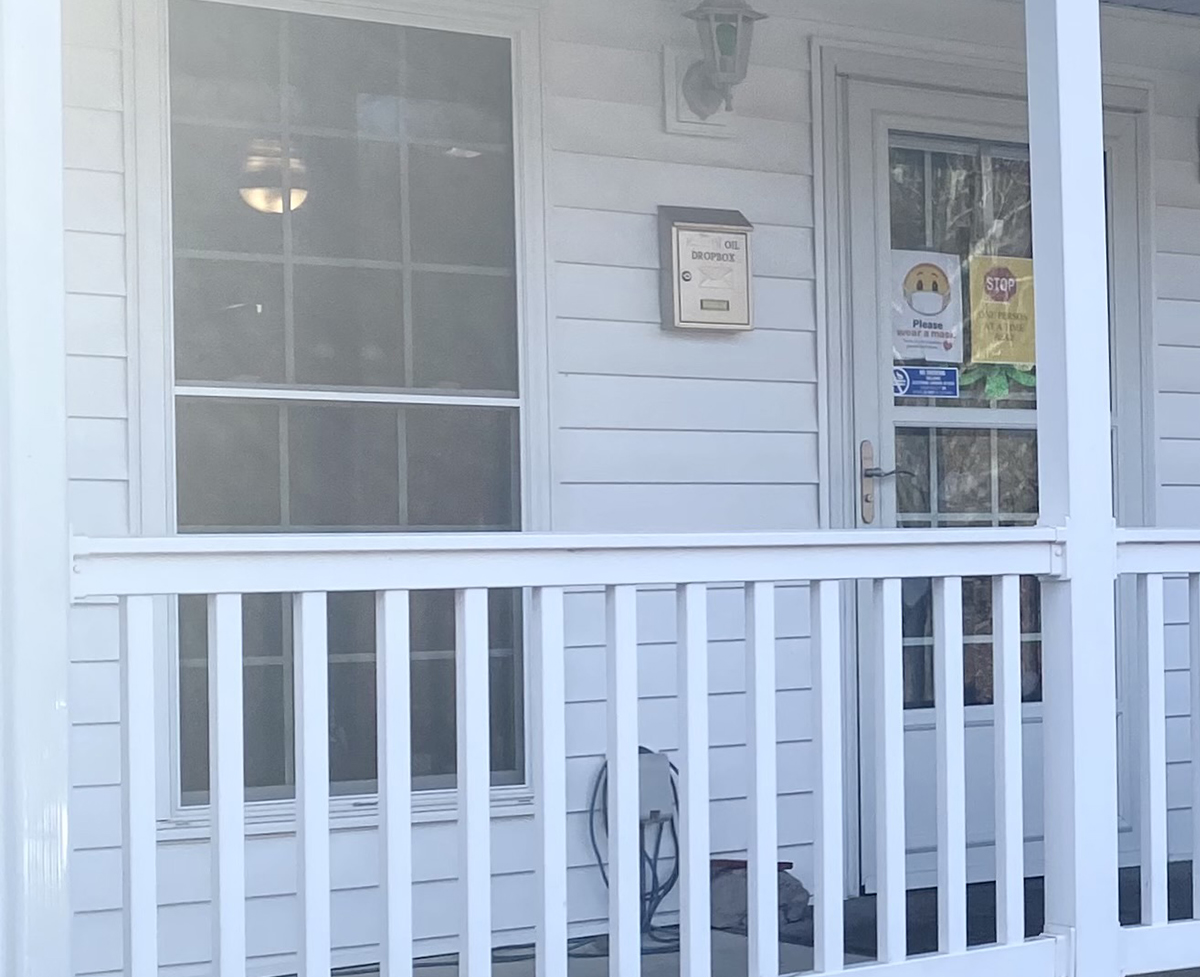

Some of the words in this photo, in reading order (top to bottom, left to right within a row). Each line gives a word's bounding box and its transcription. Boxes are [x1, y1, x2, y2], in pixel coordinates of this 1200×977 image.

[724, 241, 740, 250] OIL
[692, 251, 735, 262] DROPBOX
[986, 277, 1015, 291] STOP
[912, 319, 944, 330] Please
[896, 329, 922, 337] wear
